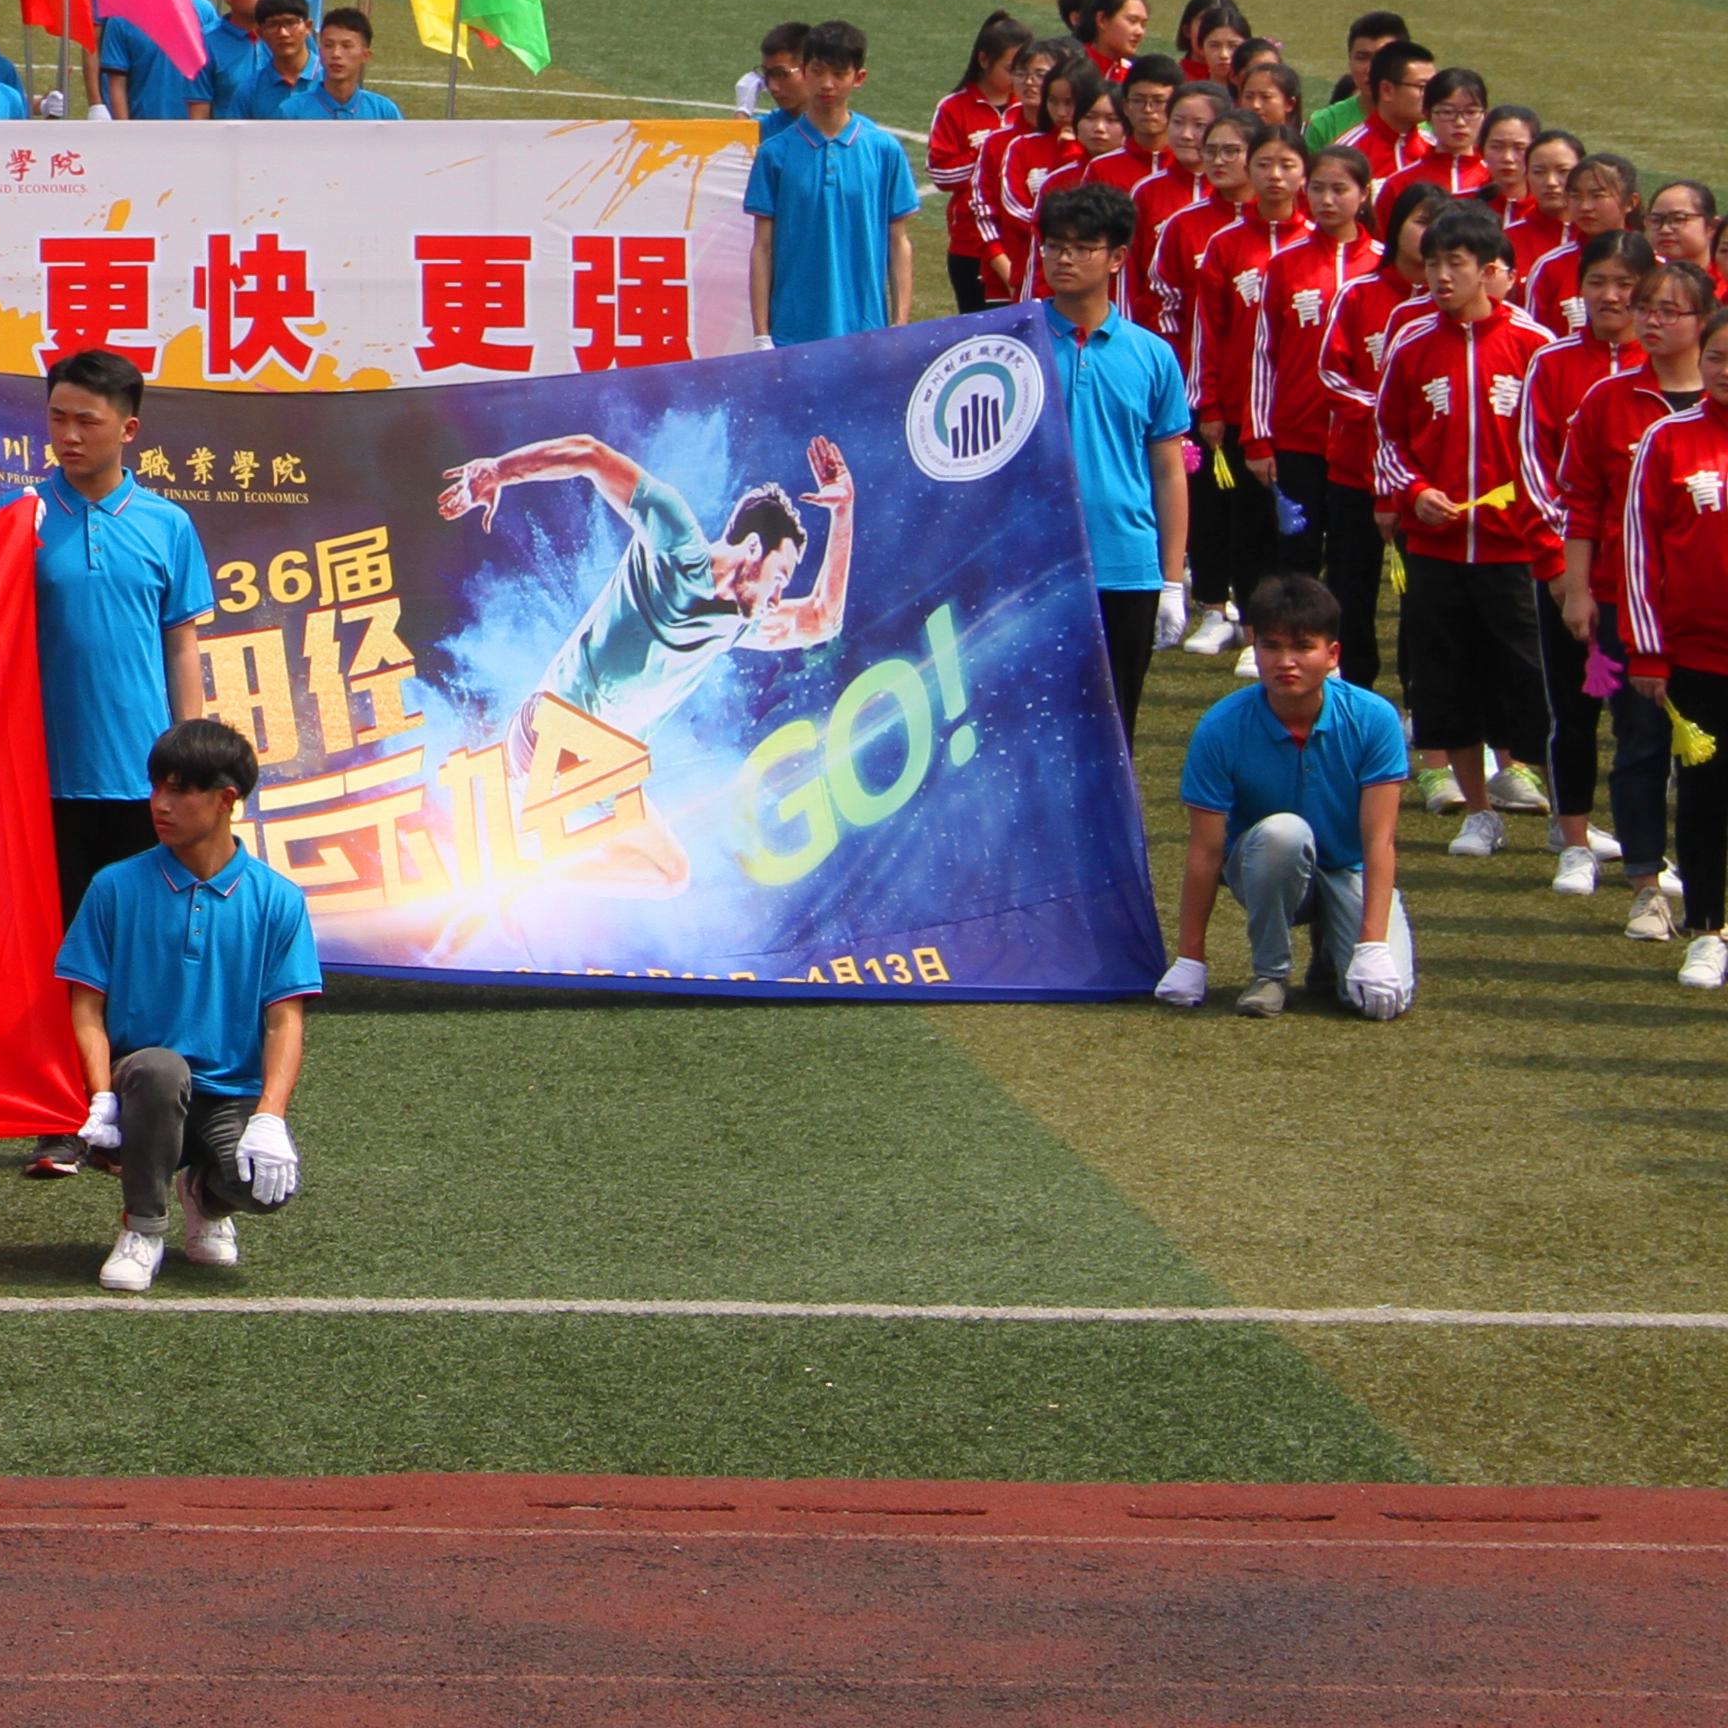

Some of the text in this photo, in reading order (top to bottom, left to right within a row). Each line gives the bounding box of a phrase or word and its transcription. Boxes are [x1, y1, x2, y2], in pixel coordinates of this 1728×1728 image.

[18, 184, 87, 194] ECONOMICS
[38, 234, 315, 374] 更快
[413, 235, 694, 373] 更强
[1233, 267, 1262, 307] 青
[1292, 289, 1323, 328] 青
[164, 488, 211, 502] FINANCE
[215, 490, 240, 503] AND
[244, 492, 310, 504] ECONOMICS
[1684, 469, 1724, 515] 青
[198, 596, 424, 765] 田径
[736, 603, 977, 887] GO!
